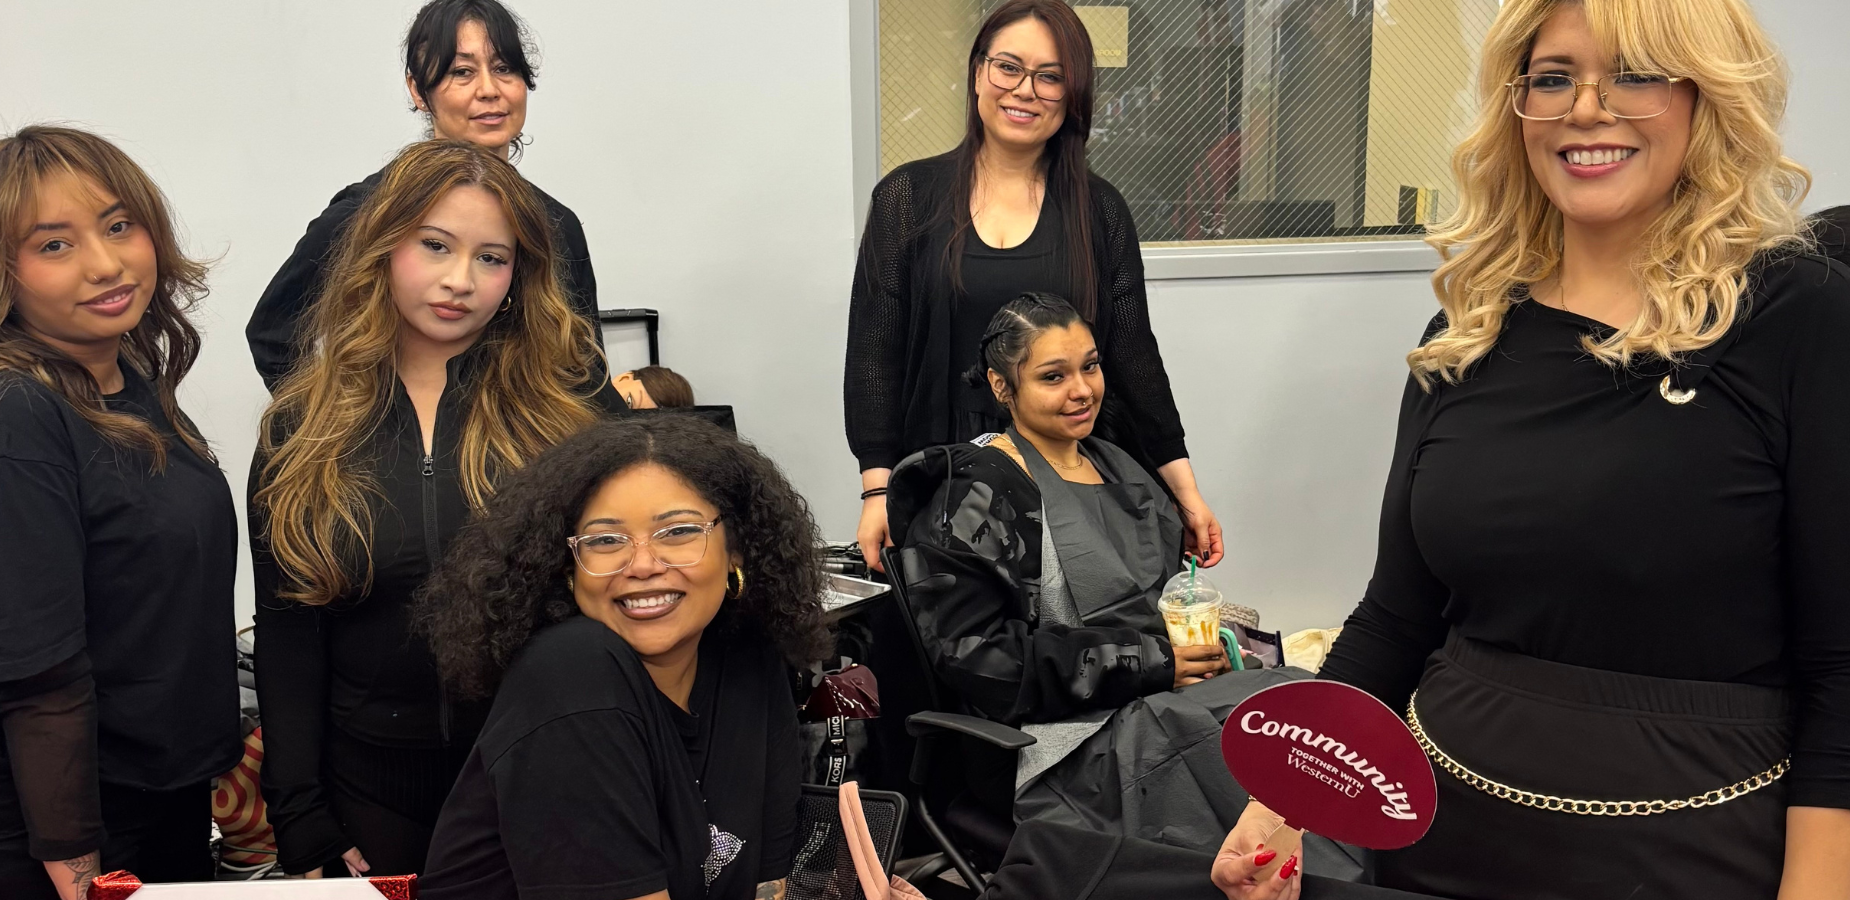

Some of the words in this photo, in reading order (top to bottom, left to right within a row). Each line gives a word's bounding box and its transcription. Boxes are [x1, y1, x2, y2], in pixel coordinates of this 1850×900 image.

[830, 757, 843, 783] KORS
[1240, 710, 1417, 820] Community
[1286, 753, 1361, 799] WesternU
[1291, 746, 1339, 775] TOGETHER
[1340, 771, 1364, 791] WITH
